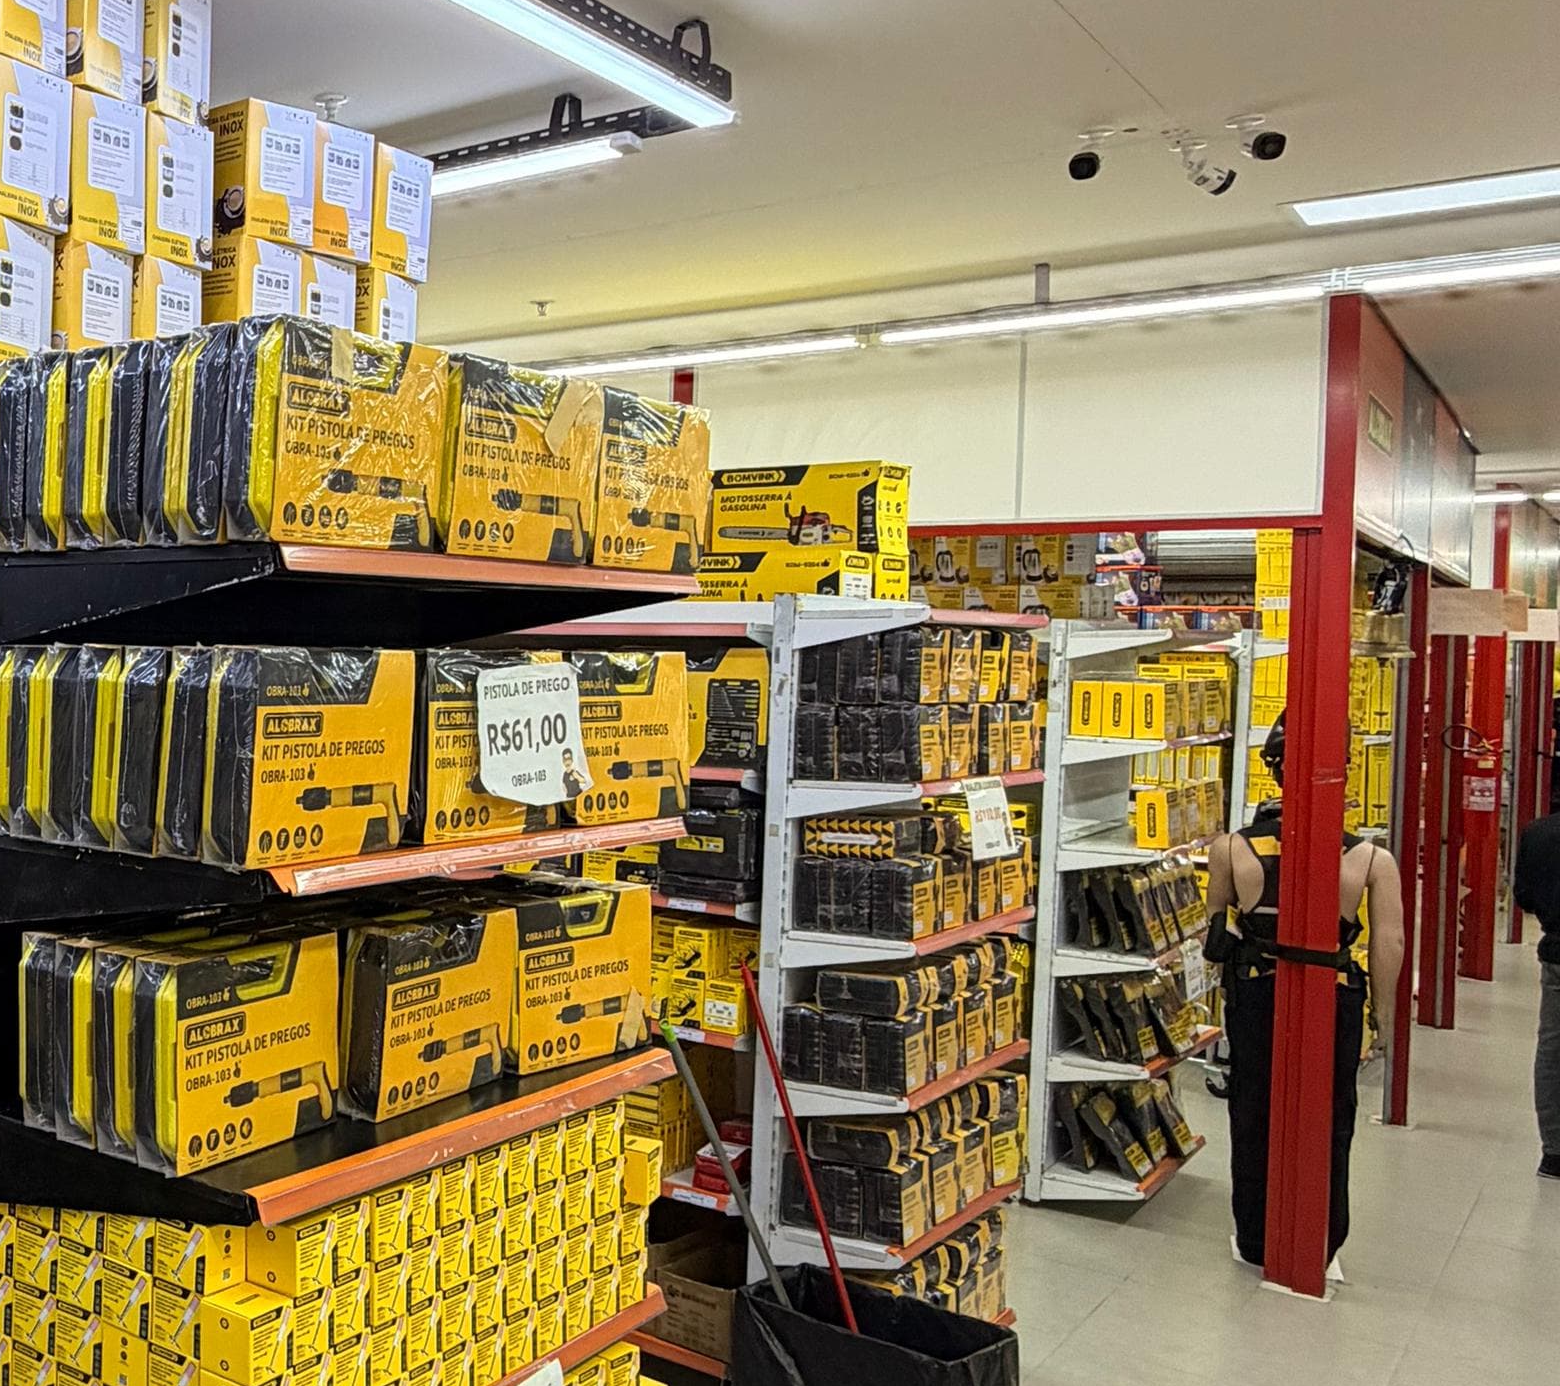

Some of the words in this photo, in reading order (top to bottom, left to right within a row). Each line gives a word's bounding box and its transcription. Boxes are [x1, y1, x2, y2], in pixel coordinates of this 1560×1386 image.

[218, 120, 244, 137] INOX
[17, 203, 39, 219] INOX
[98, 227, 118, 240] INOX
[269, 226, 289, 238] INOX
[170, 244, 188, 258] INOX
[287, 415, 306, 430] KIT
[308, 417, 354, 440] PISTOLA
[372, 430, 415, 450] PREGOS
[464, 441, 480, 456] KIT
[482, 444, 520, 463] PISTOLA
[521, 452, 533, 465] DE
[535, 453, 571, 471] PREGOS
[463, 464, 500, 480] OBRA-103
[726, 471, 775, 483] BOMVINK
[720, 493, 782, 504] MOTOSSERRA
[720, 503, 767, 513] GASOLINA
[484, 682, 520, 700] PISTOLA
[522, 680, 534, 695] DE
[536, 677, 570, 693] PREGO
[487, 713, 567, 757] R$61,00
[595, 725, 626, 740] PISTOLA
[628, 724, 638, 737] DE
[639, 723, 669, 737] PREGOS
[262, 744, 280, 761] KIT
[282, 742, 326, 759] PISTOLA
[329, 742, 342, 756] DE
[345, 739, 385, 755] PREGOS
[435, 735, 450, 750] KIT
[435, 756, 473, 770] OBRA-103
[261, 768, 305, 784] OBRA-103
[512, 769, 547, 787] OBRA-103
[525, 976, 540, 992] KIT
[542, 969, 579, 988] PISTOLA
[581, 966, 592, 980] DE
[594, 959, 630, 977] PREGOS
[186, 992, 222, 1010] OBRA-103
[526, 991, 562, 1009] OBRA-103
[391, 1013, 405, 1030] KIT
[407, 1005, 444, 1025] PISTOLA
[445, 999, 457, 1013] DE
[458, 989, 491, 1009] PREGOS
[185, 1052, 204, 1071] KIT
[206, 1038, 252, 1064] PISTOLA
[254, 1033, 268, 1052] DE
[270, 1022, 311, 1047] PREGOS
[390, 1029, 426, 1048] OBRA-103
[186, 1068, 231, 1092] OBRA-103
